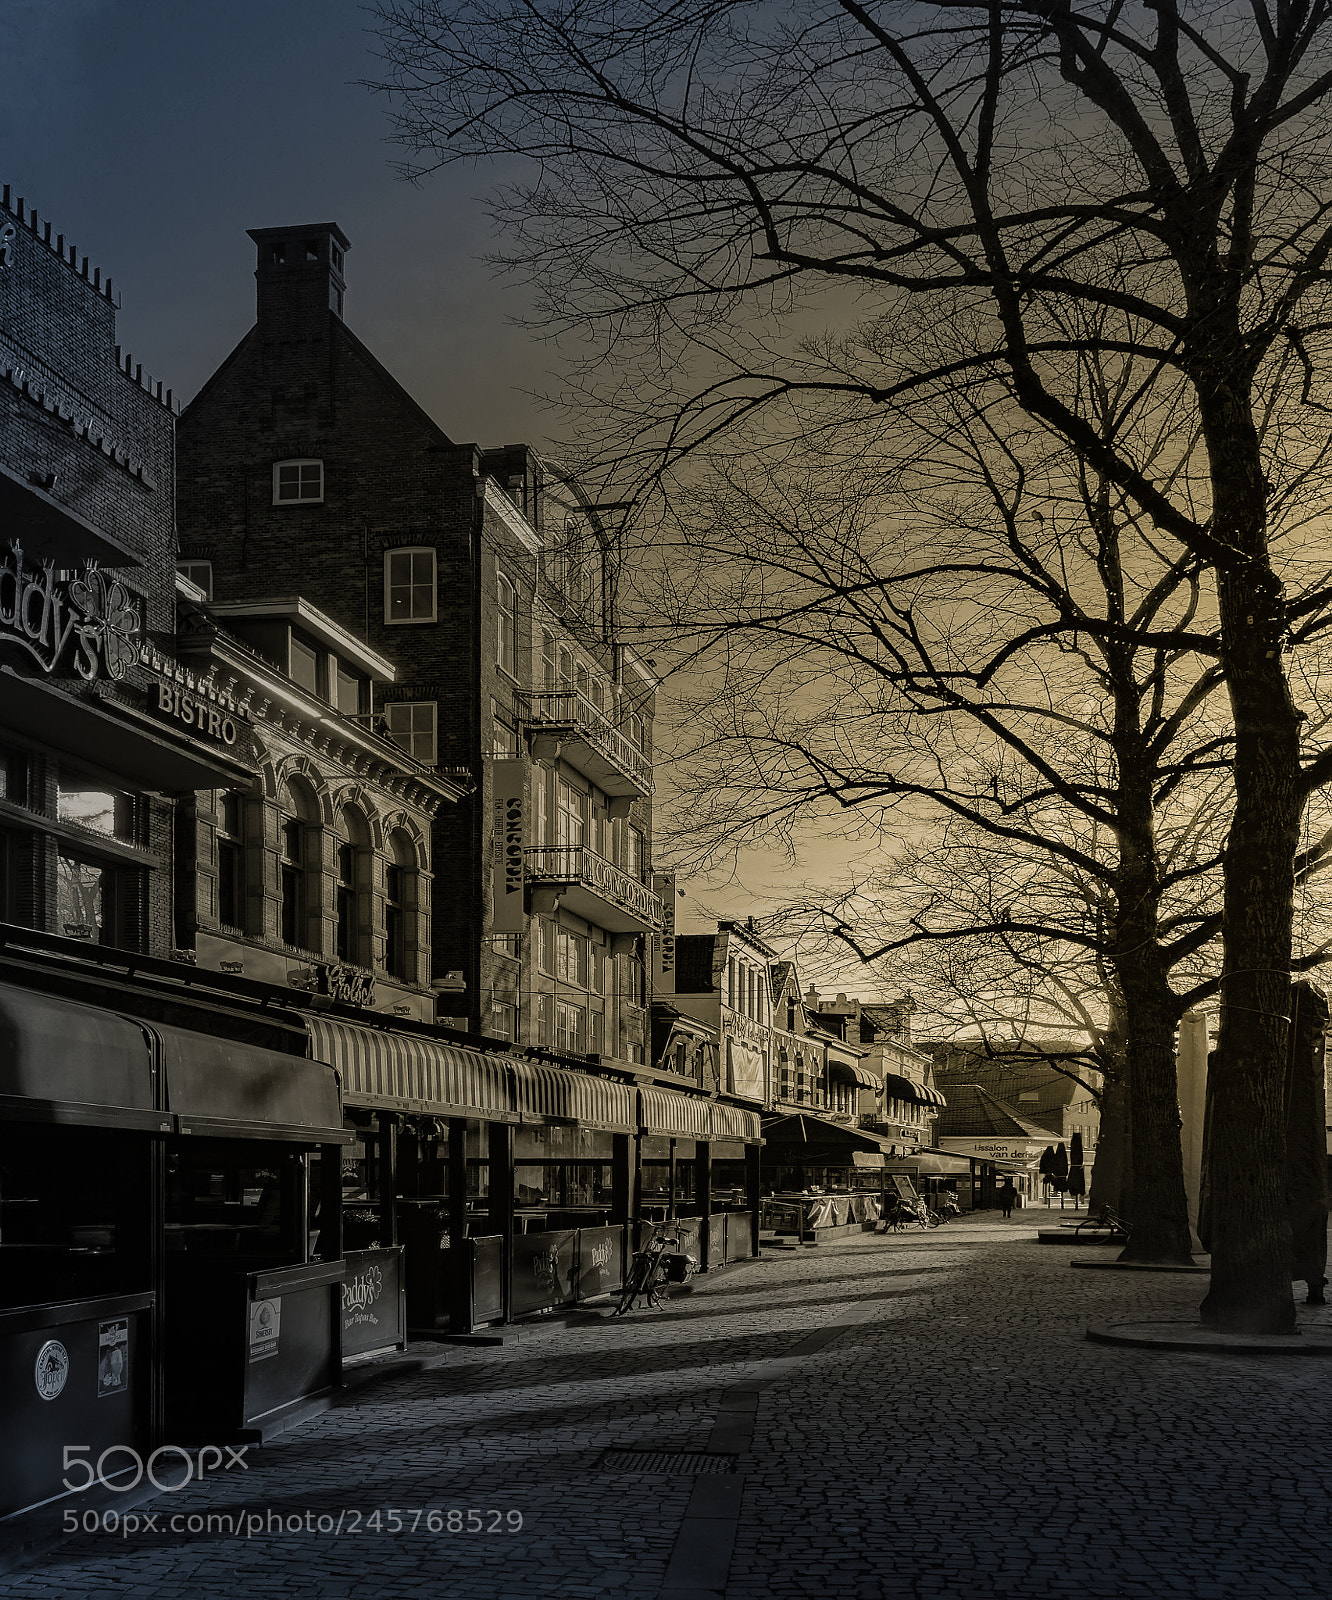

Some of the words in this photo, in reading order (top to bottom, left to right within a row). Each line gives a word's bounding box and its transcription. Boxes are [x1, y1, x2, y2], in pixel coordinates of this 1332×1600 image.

[157, 681, 238, 745] BISTRO
[506, 797, 523, 896] CONCORDIA
[325, 964, 377, 1007] Grolsch
